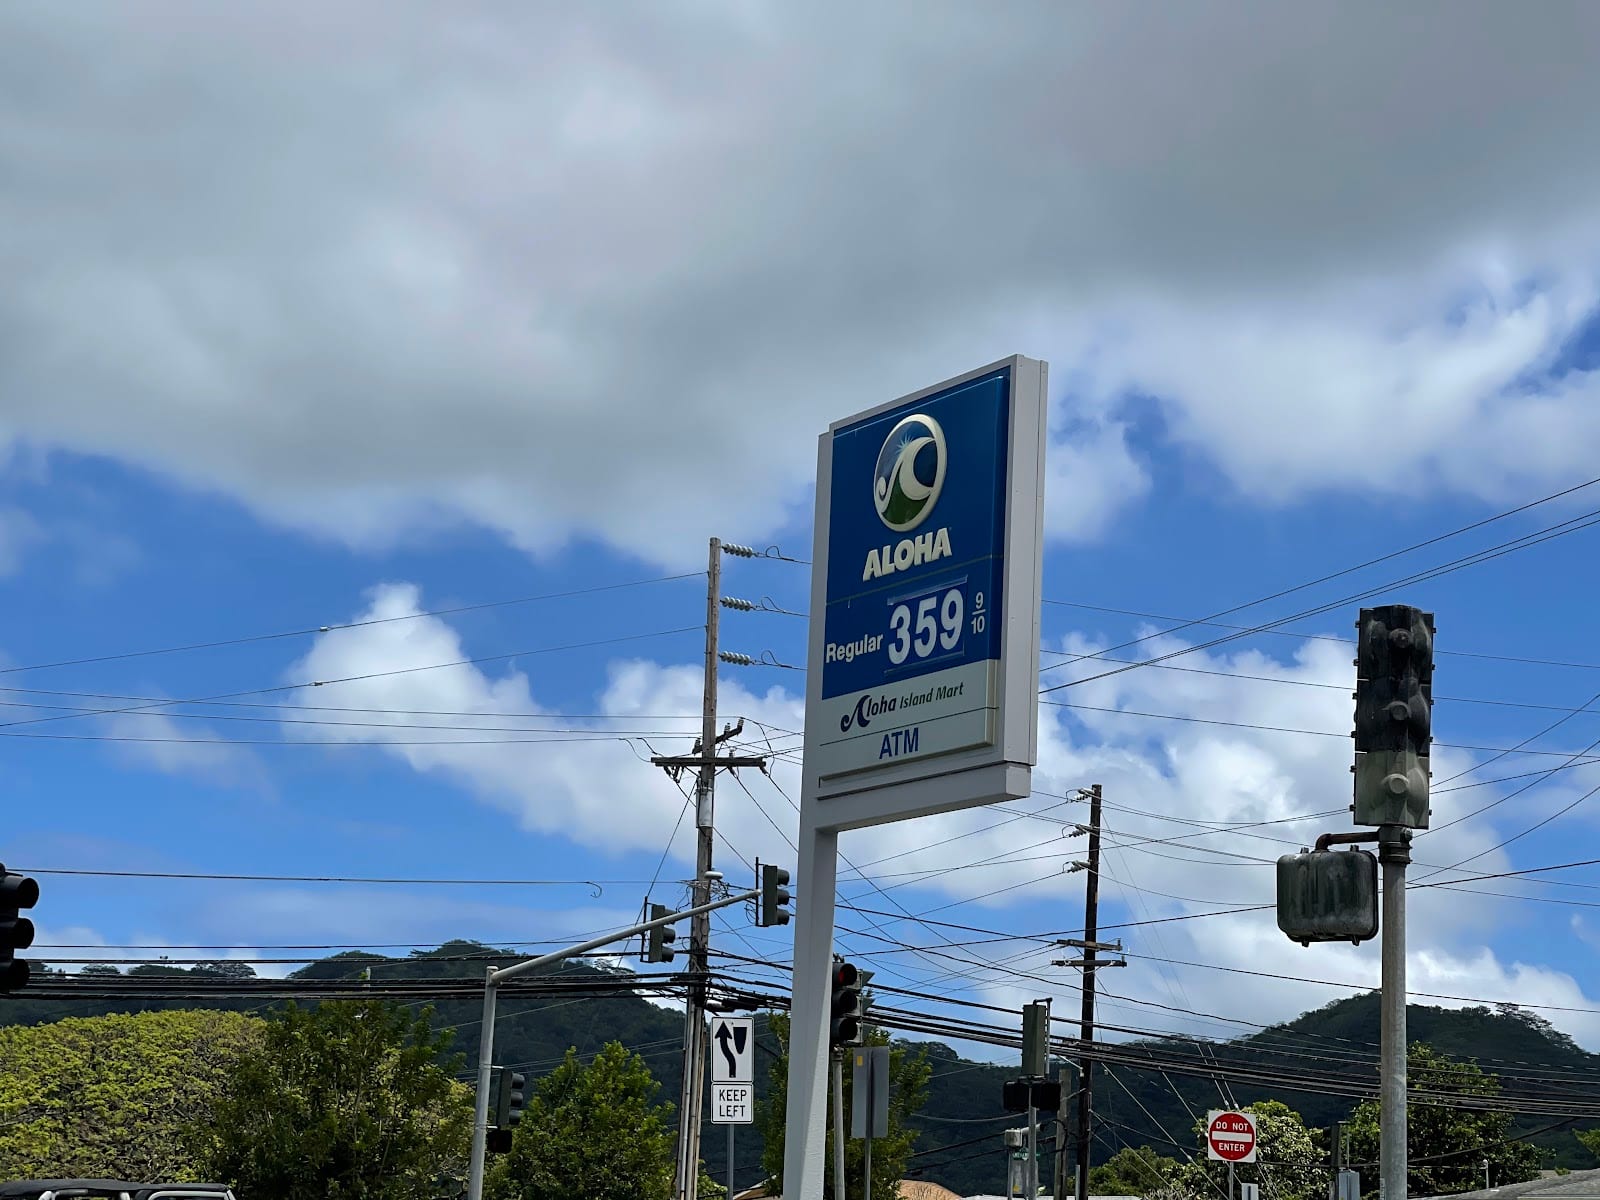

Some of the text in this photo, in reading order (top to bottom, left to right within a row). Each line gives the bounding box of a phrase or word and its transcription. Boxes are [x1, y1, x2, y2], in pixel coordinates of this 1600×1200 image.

[862, 527, 952, 581] ALOHA
[825, 588, 963, 665] Regular 359
[840, 682, 964, 732] Aloha Island Mart
[879, 727, 919, 760] ATM
[719, 1089, 747, 1101] KEEP
[719, 1105, 746, 1117] LEFT
[1215, 1121, 1249, 1132] DO NOT
[1218, 1142, 1245, 1152] ENTER
